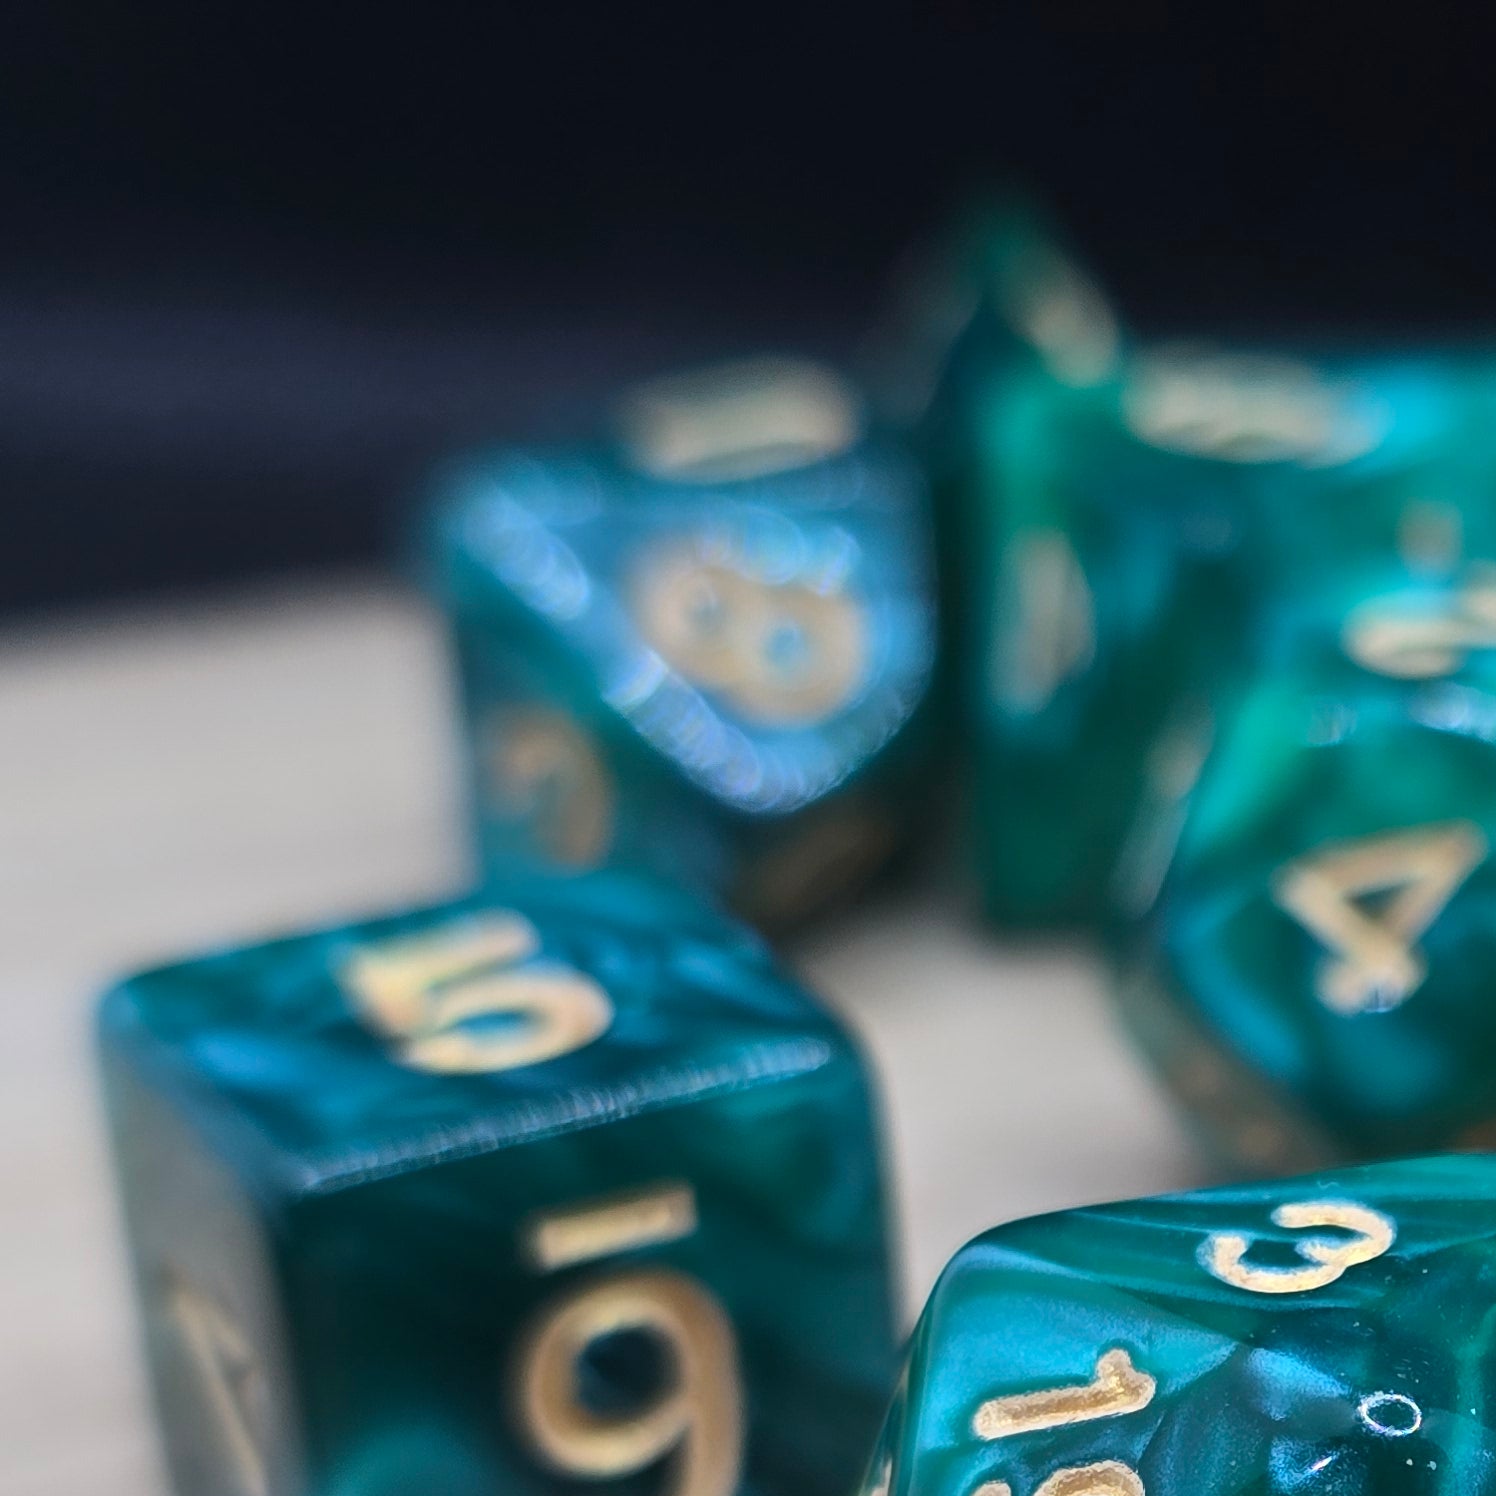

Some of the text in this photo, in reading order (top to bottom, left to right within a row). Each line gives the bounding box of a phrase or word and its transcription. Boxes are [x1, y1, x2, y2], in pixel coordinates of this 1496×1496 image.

[342, 905, 615, 1077] 5
[1270, 820, 1490, 1018] 4
[1202, 1202, 1395, 1294] 3
